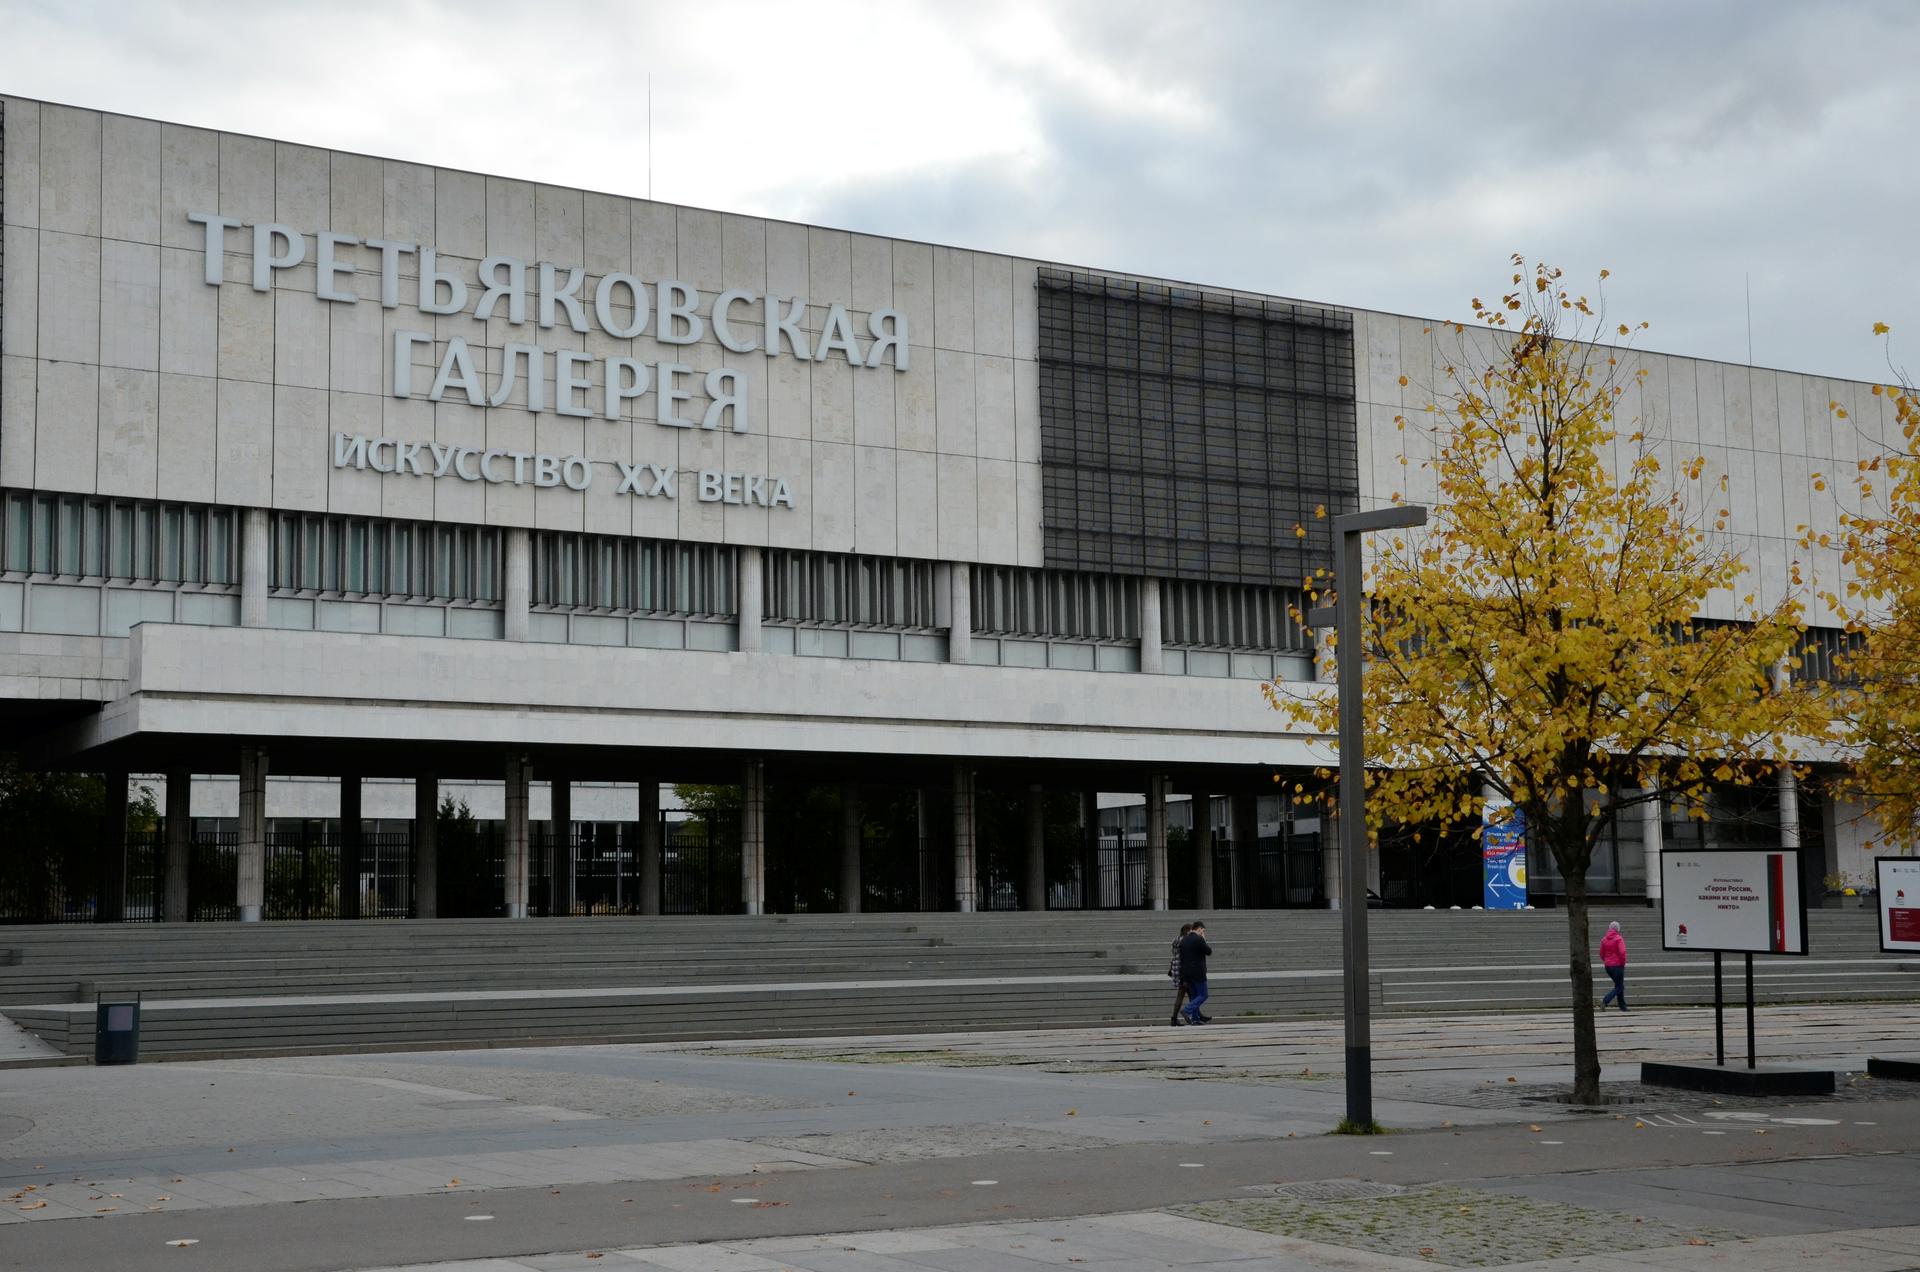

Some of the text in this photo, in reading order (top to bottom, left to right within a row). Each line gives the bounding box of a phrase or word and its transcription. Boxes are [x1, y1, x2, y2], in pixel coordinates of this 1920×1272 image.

[187, 212, 909, 372] ТРЕТЬЯКОВСКАЯ
[394, 328, 749, 433] ГАЛЕРЕЯ
[334, 432, 592, 490] ИСКУССТВО
[698, 470, 796, 509] ВЕКА
[1728, 885, 1752, 893] России,
